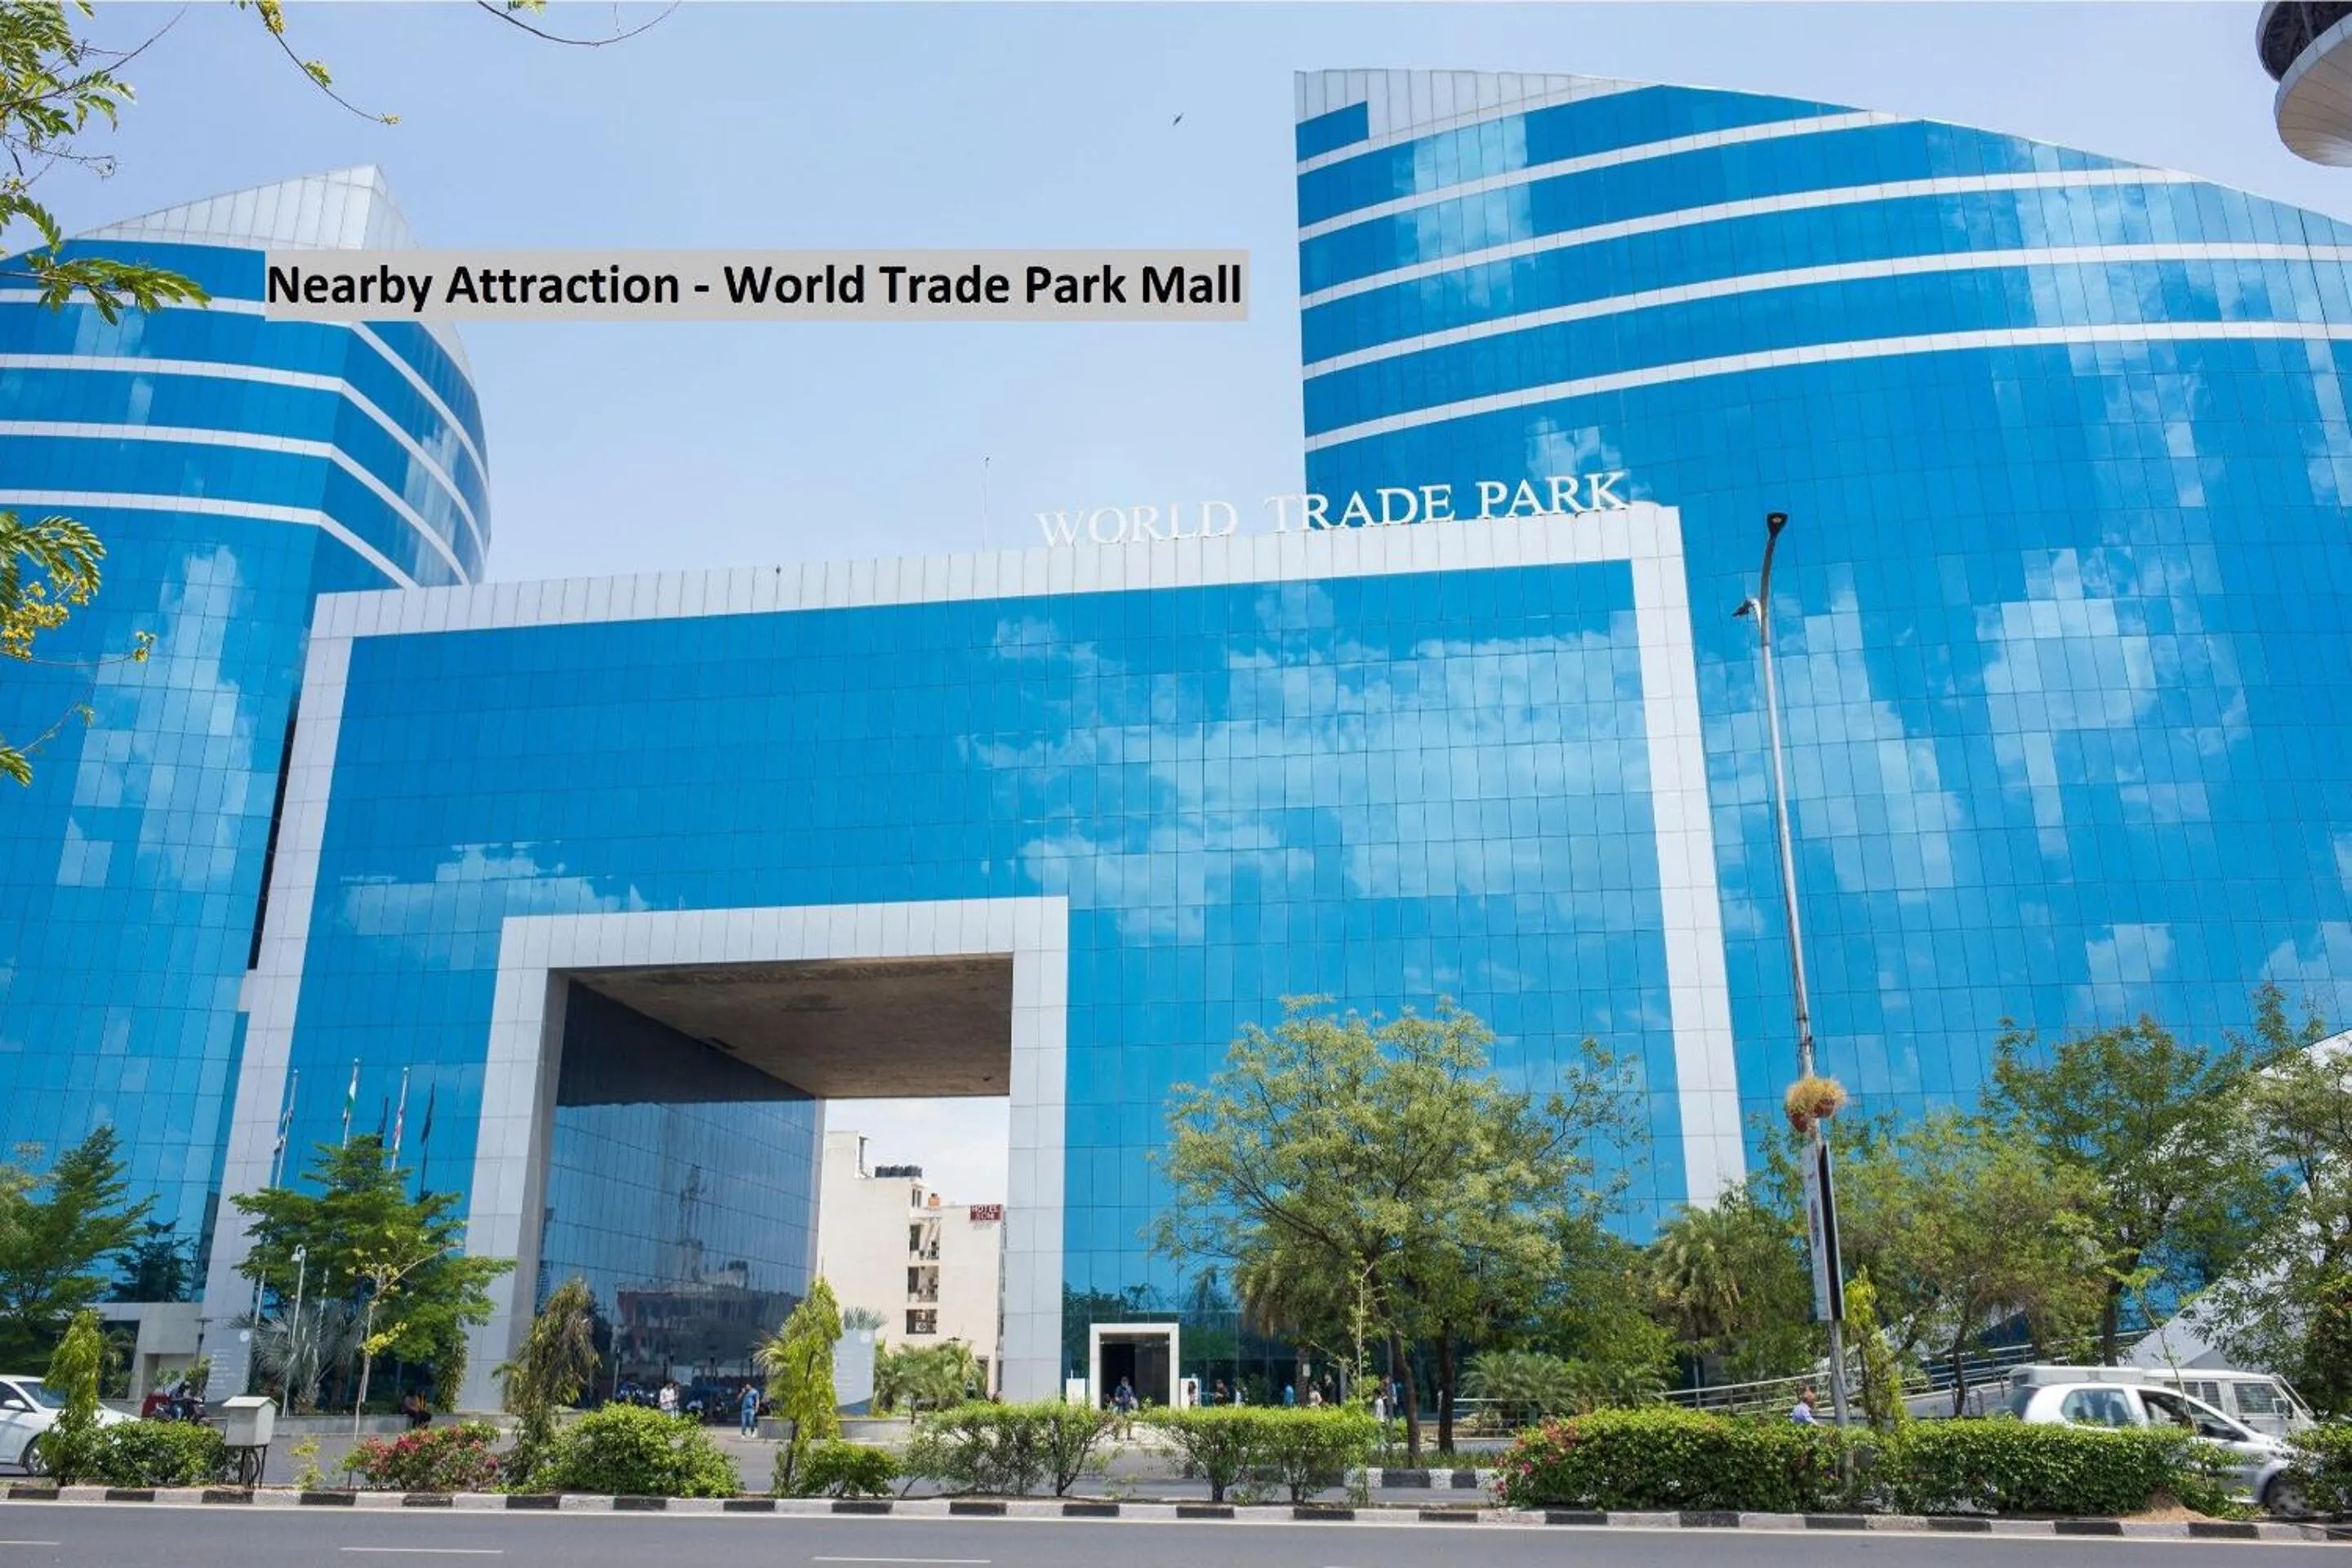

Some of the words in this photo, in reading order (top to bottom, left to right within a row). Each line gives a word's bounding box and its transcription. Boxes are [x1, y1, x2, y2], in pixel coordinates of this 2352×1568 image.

[1035, 501, 1239, 548] WORLD
[1264, 483, 1454, 533] TRADE
[1475, 470, 1632, 520] PARK
[972, 1205, 999, 1213] HOTEL
